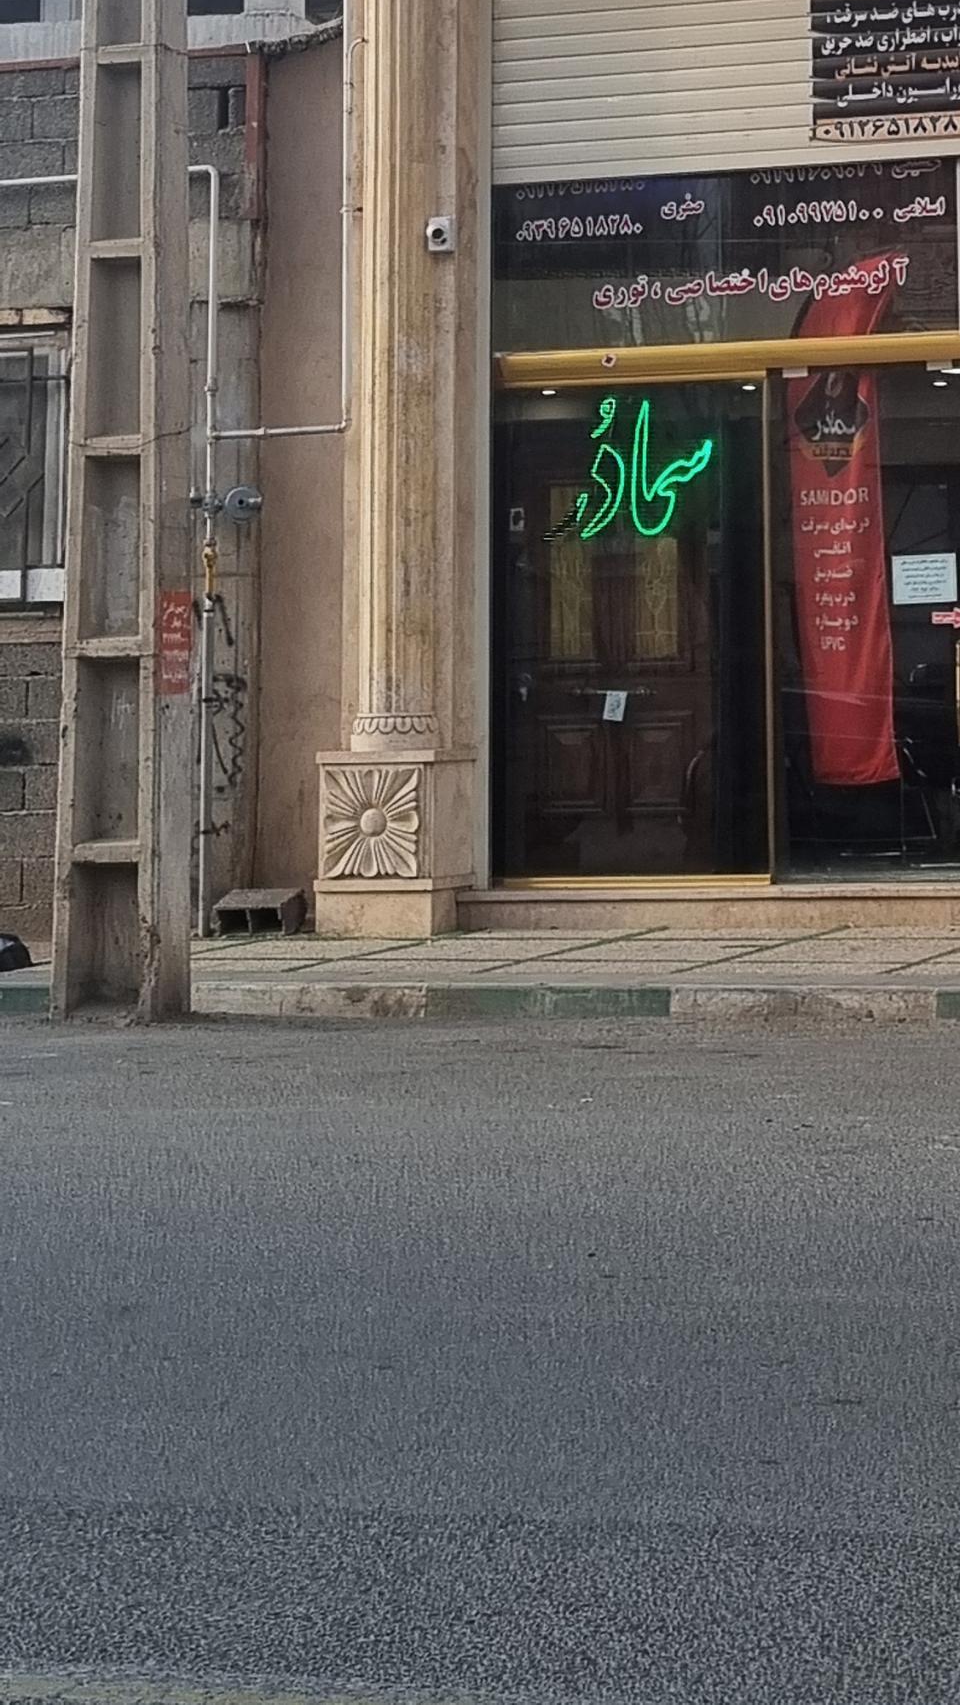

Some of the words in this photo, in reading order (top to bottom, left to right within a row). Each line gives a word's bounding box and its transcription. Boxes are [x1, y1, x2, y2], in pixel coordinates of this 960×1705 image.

[869, 1, 899, 21] ضد
[901, 0, 936, 23] های
[821, 35, 853, 55] حریق
[855, 30, 875, 47] ضد
[836, 80, 894, 108] داخلی
[893, 196, 946, 222] اسلامی
